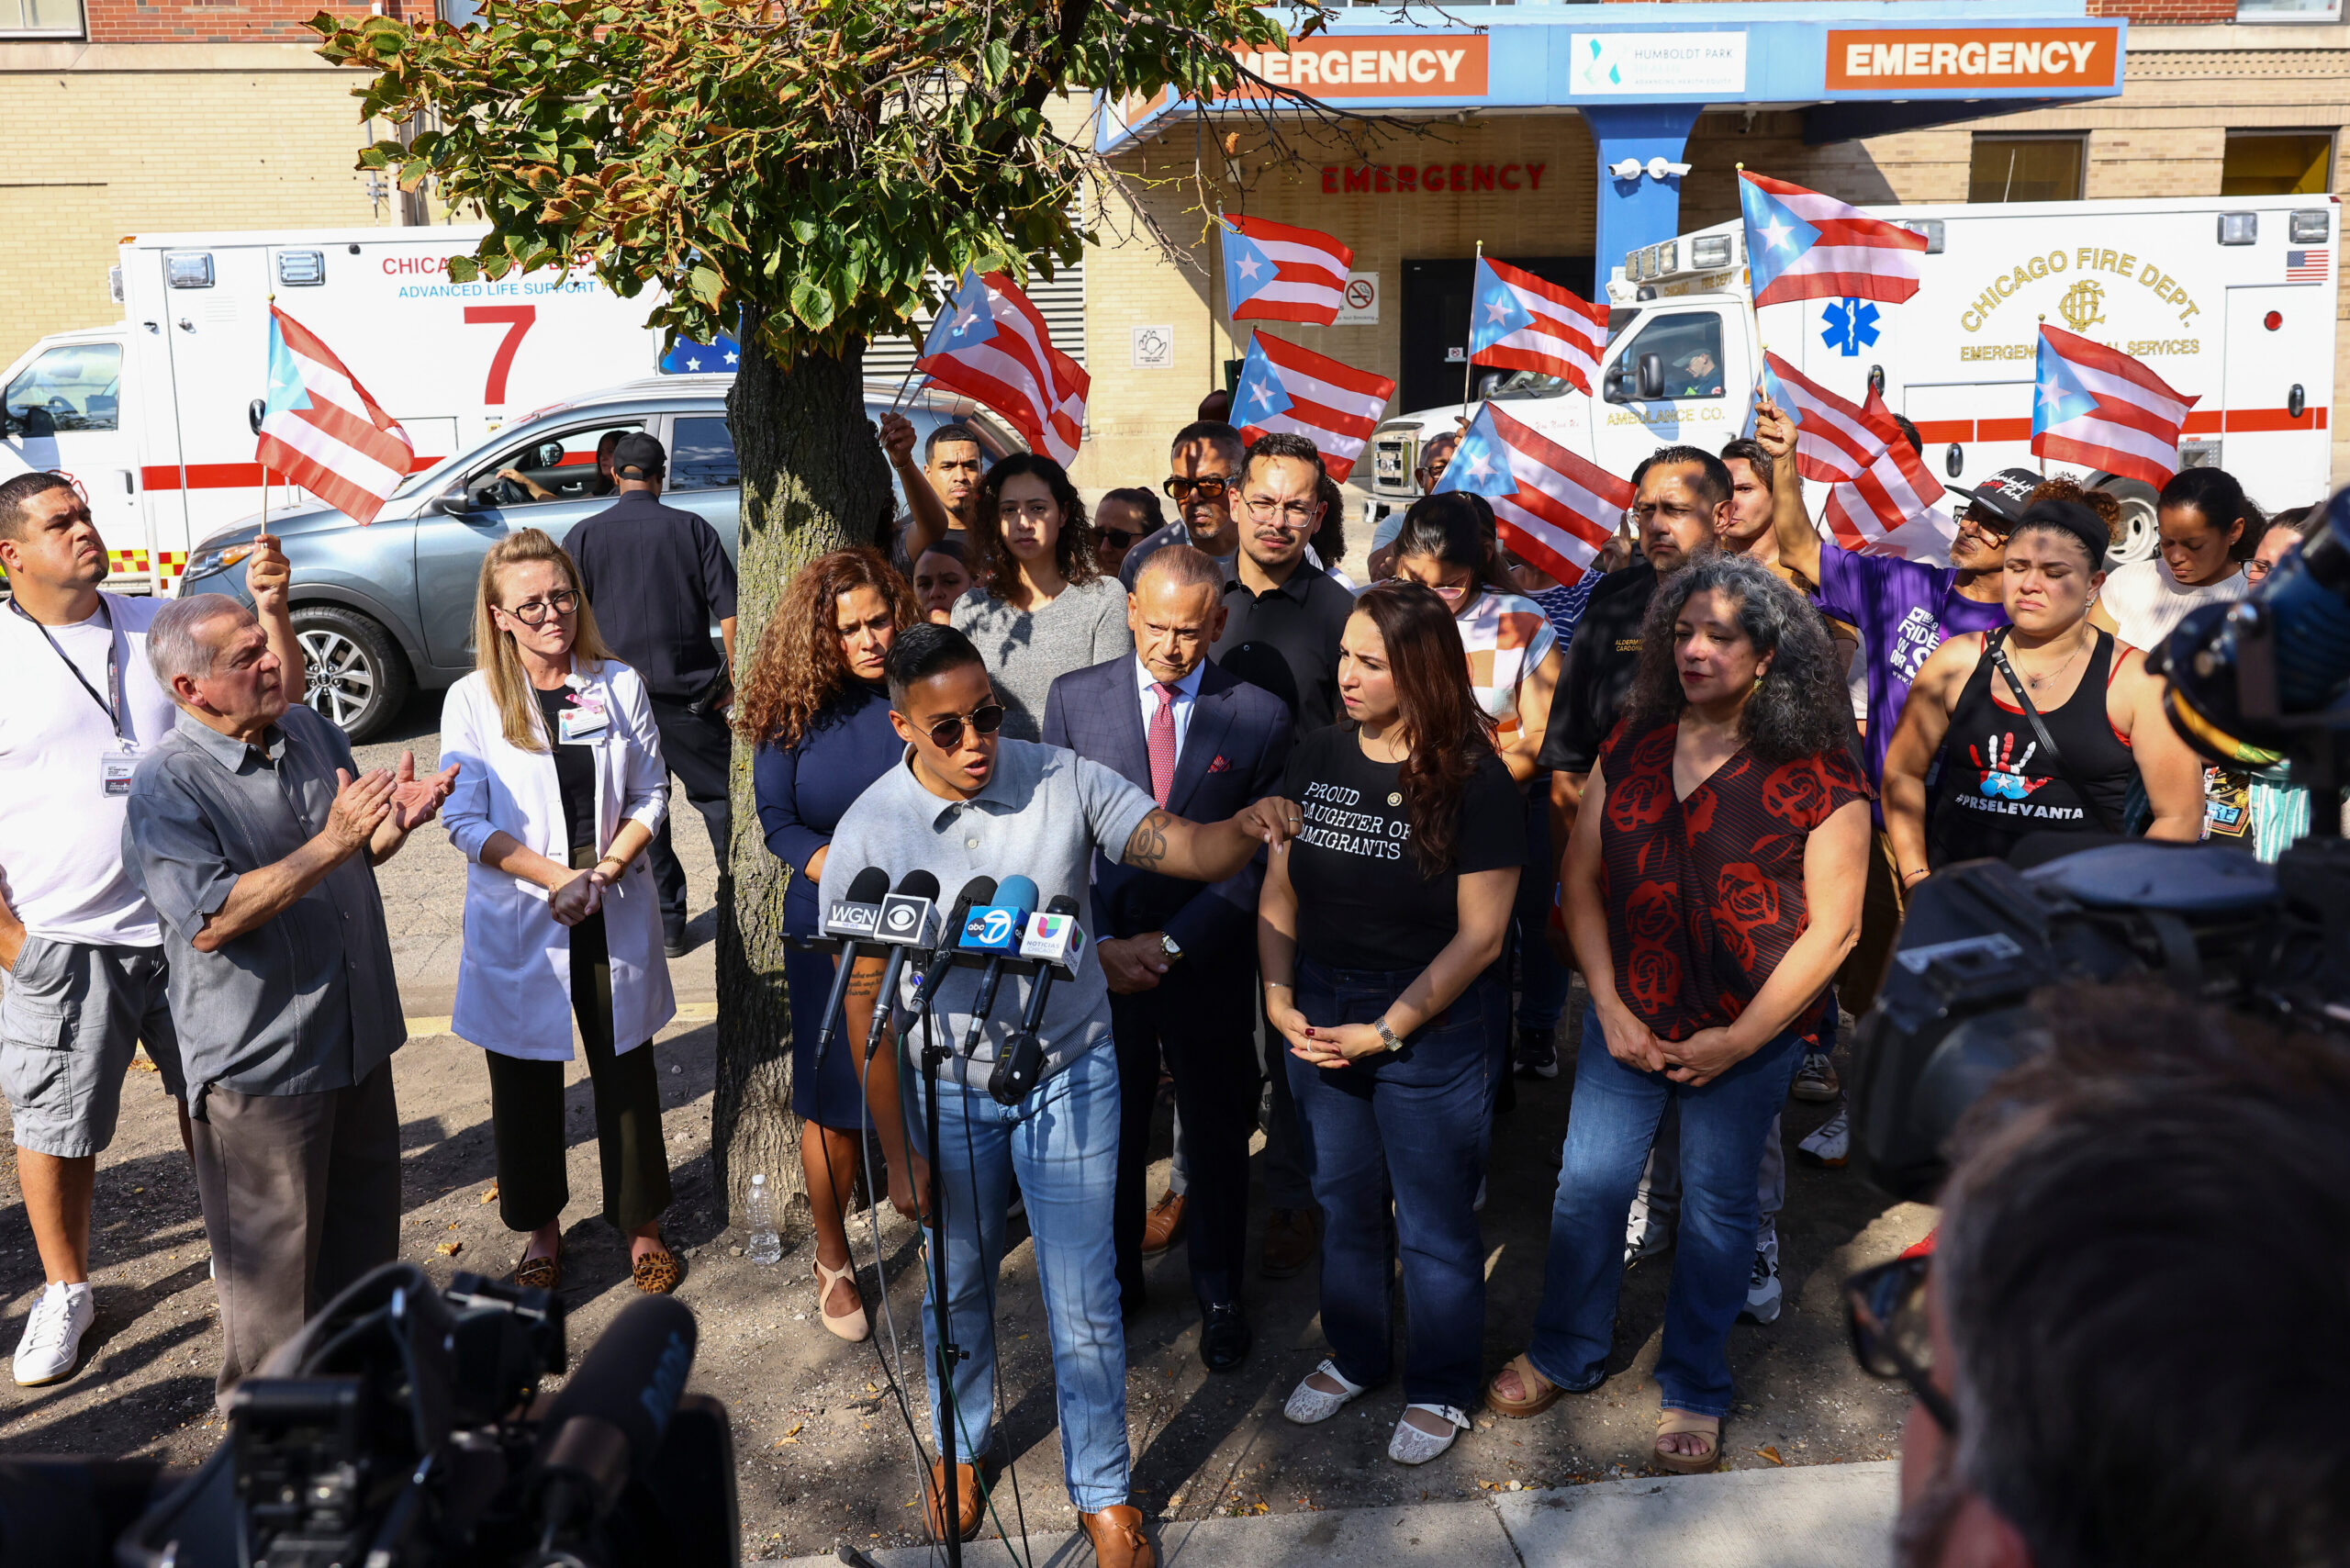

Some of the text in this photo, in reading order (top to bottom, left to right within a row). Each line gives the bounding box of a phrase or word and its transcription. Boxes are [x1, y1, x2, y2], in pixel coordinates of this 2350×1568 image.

[1635, 49, 1733, 60] HUMBOLDT PARK
[1846, 41, 2097, 76] EMERGENCY
[1212, 50, 1466, 84] MERGENCY
[1322, 163, 1546, 194] EMERGENCY
[383, 257, 448, 274] CHICA
[398, 281, 596, 298] ADVANCED LIFE SUPPORT
[1961, 247, 2200, 332] CHICAGO FIRE DEPT.
[464, 304, 536, 405] 7
[1960, 344, 2039, 362] EMERGEN
[2126, 338, 2200, 356] SERVICES
[1606, 407, 1726, 427] AMBULANCE CO.
[1889, 648, 1908, 670] OUR
[1304, 781, 1360, 806] PROUD
[1954, 792, 2084, 820] #PRSELEVANTA
[1301, 801, 1413, 840] DAUGHTER OF
[1295, 823, 1401, 860] MMIGRANTS
[832, 904, 878, 925] WGN
[968, 923, 985, 932] abc
[979, 909, 1012, 945] 7
[1026, 939, 1060, 949] NOTICIAS
